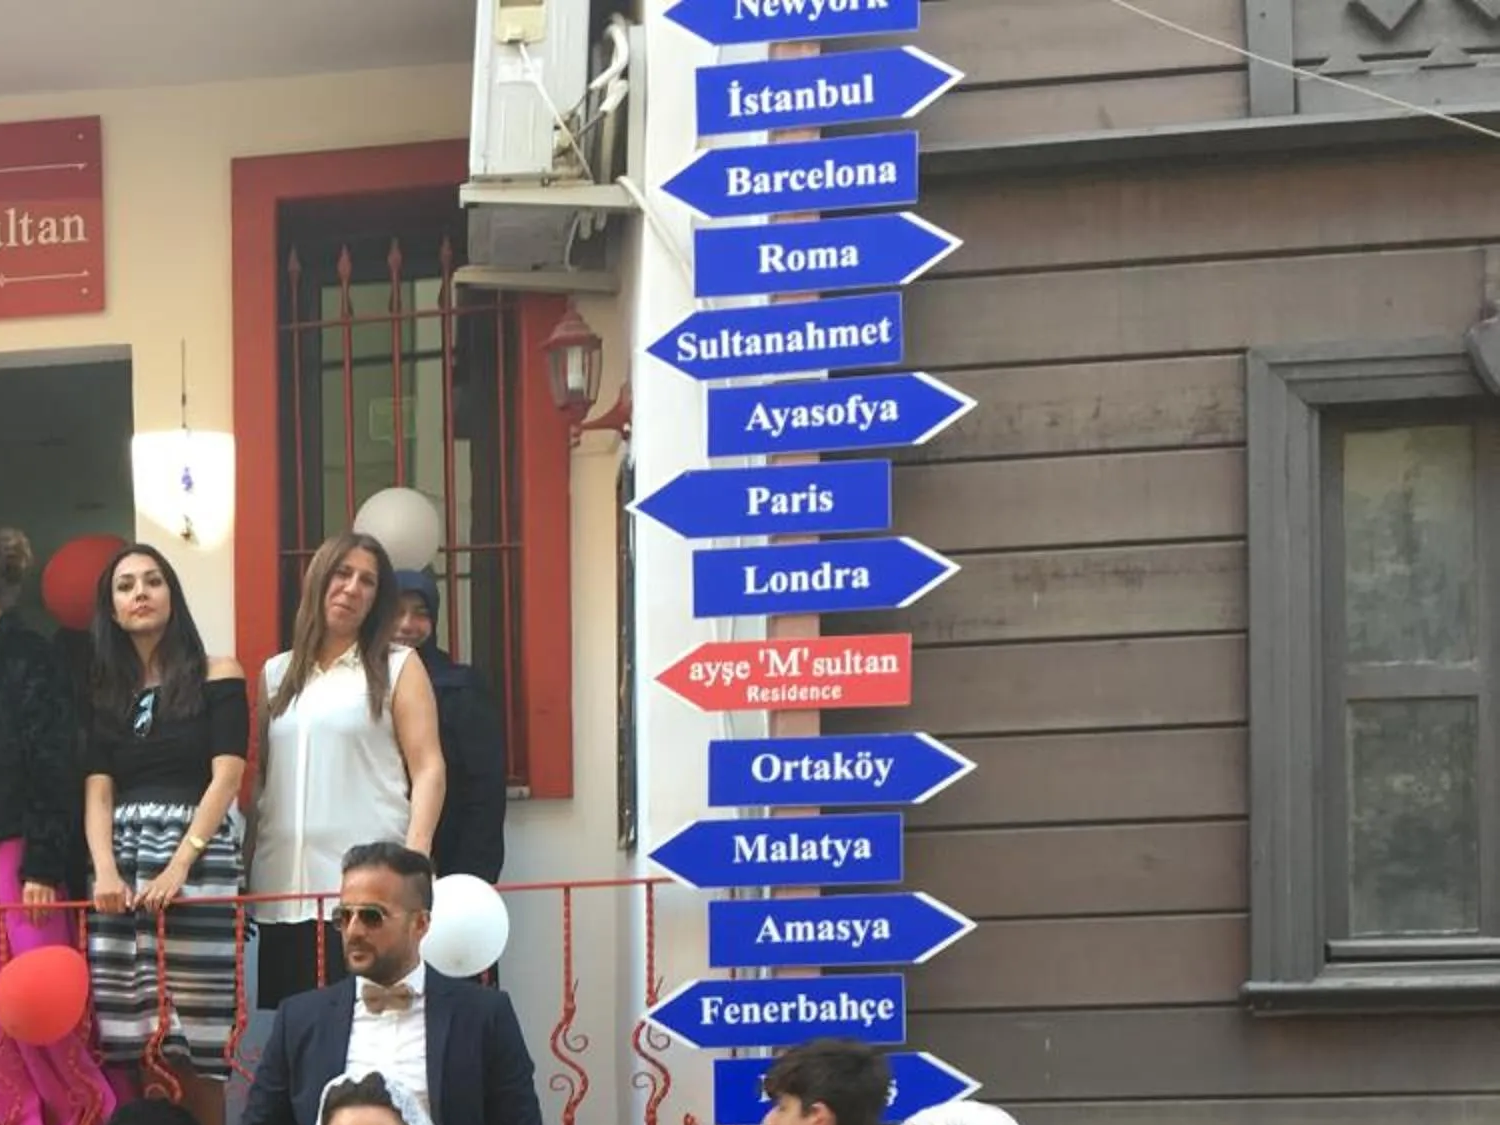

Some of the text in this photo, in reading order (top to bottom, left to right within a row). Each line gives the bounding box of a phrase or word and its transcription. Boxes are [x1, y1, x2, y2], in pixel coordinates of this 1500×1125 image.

[734, 0, 889, 21] Newyo
[728, 74, 874, 117] İstanbul
[727, 160, 897, 197] Barcelona
[758, 244, 859, 274] Roma
[677, 316, 892, 361] Sultanahmet
[745, 394, 899, 437] Ayasofya
[747, 483, 834, 516] Paris
[744, 562, 870, 595] Londra
[689, 658, 750, 686] ayşe
[746, 683, 842, 703] Residence
[751, 752, 894, 787] Ortaköy
[734, 834, 871, 867] Malatya
[756, 915, 890, 948] Amasya
[701, 993, 894, 1027] Fenerbahçe
